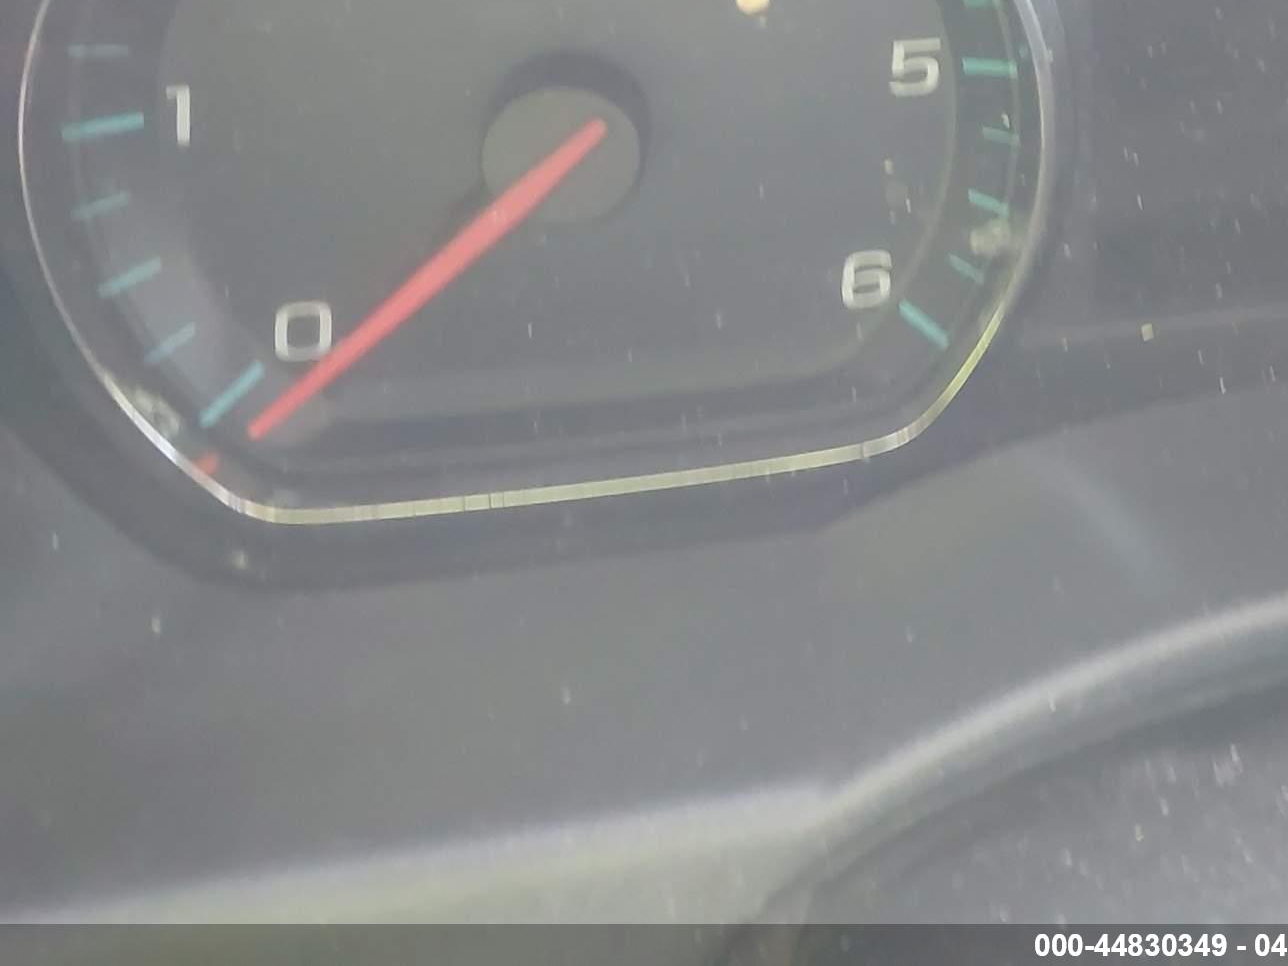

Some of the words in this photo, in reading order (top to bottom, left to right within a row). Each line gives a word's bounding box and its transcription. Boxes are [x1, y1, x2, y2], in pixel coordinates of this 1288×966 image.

[889, 37, 941, 97] 5
[165, 84, 192, 148] 1
[841, 250, 893, 310] 6
[273, 301, 333, 362] 0
